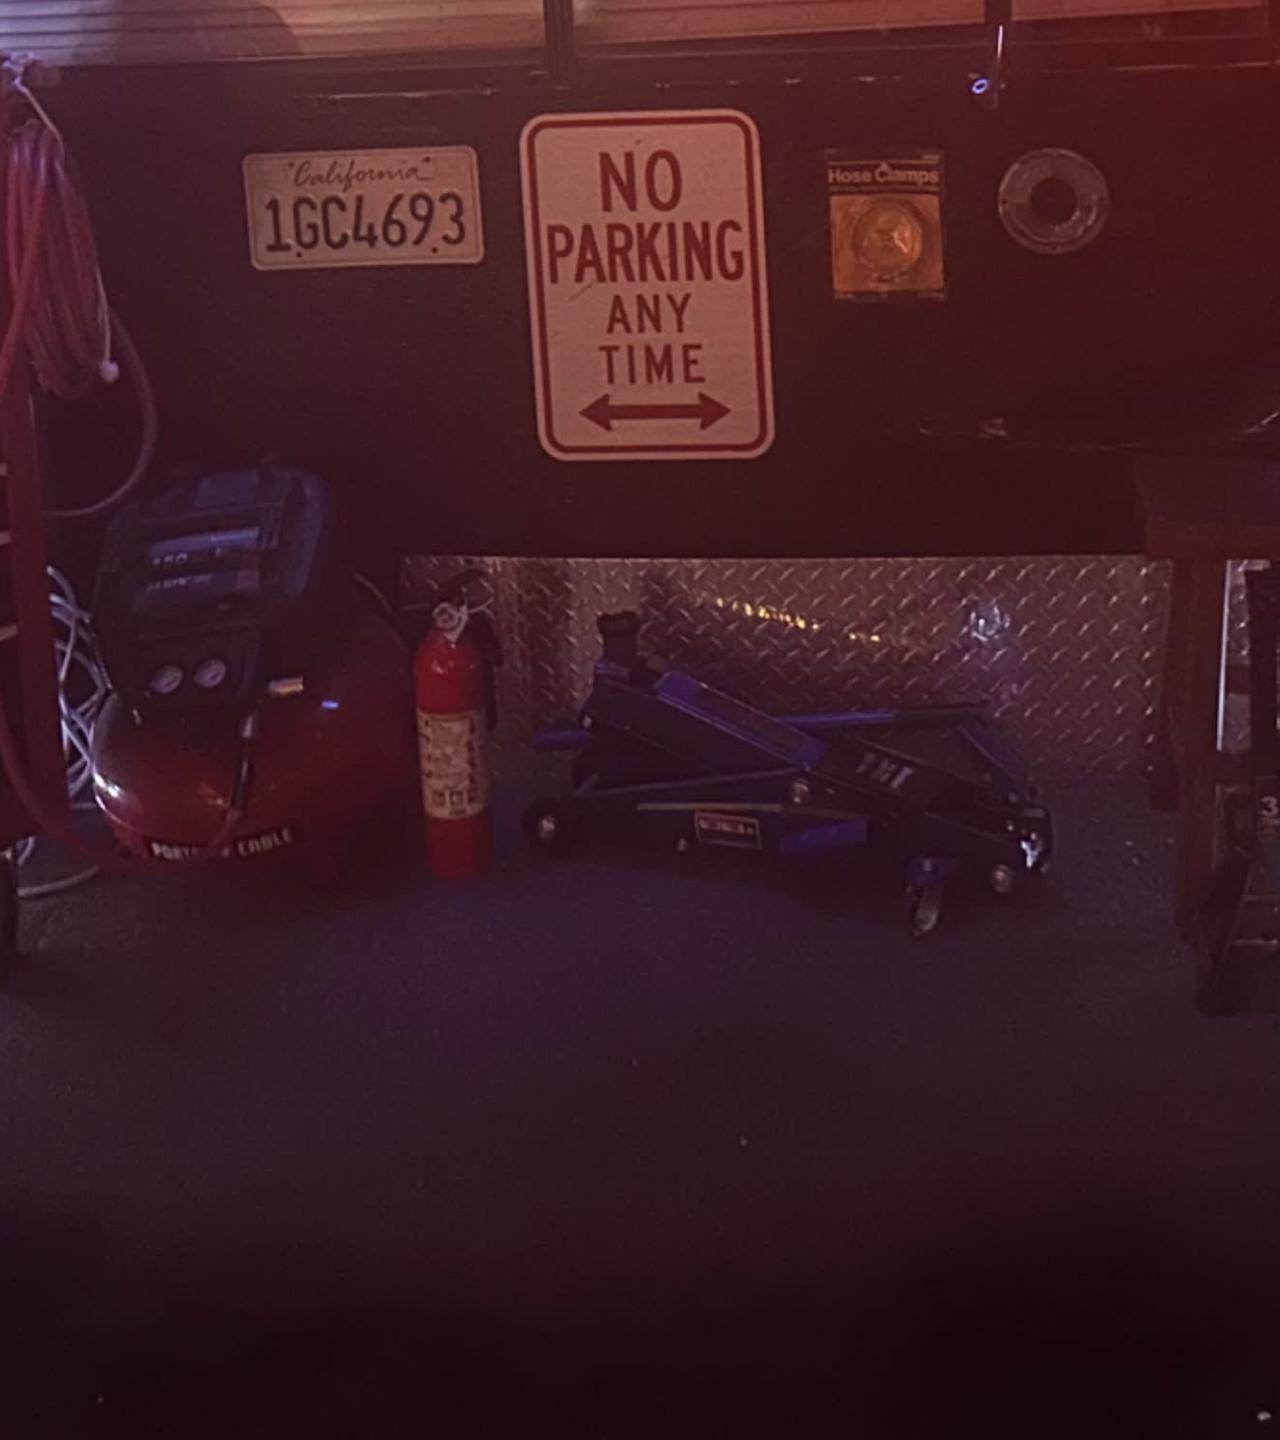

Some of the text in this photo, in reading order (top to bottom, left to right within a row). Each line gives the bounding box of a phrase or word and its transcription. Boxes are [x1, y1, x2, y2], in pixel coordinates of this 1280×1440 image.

[294, 160, 422, 192] California
[598, 150, 682, 212] NO
[828, 165, 939, 186] Hose Clamps
[265, 191, 466, 252] 1GC4693
[546, 220, 745, 284] PARKING
[606, 294, 691, 334] ANY
[598, 344, 706, 386] TIME
[237, 826, 292, 857] CABLE
